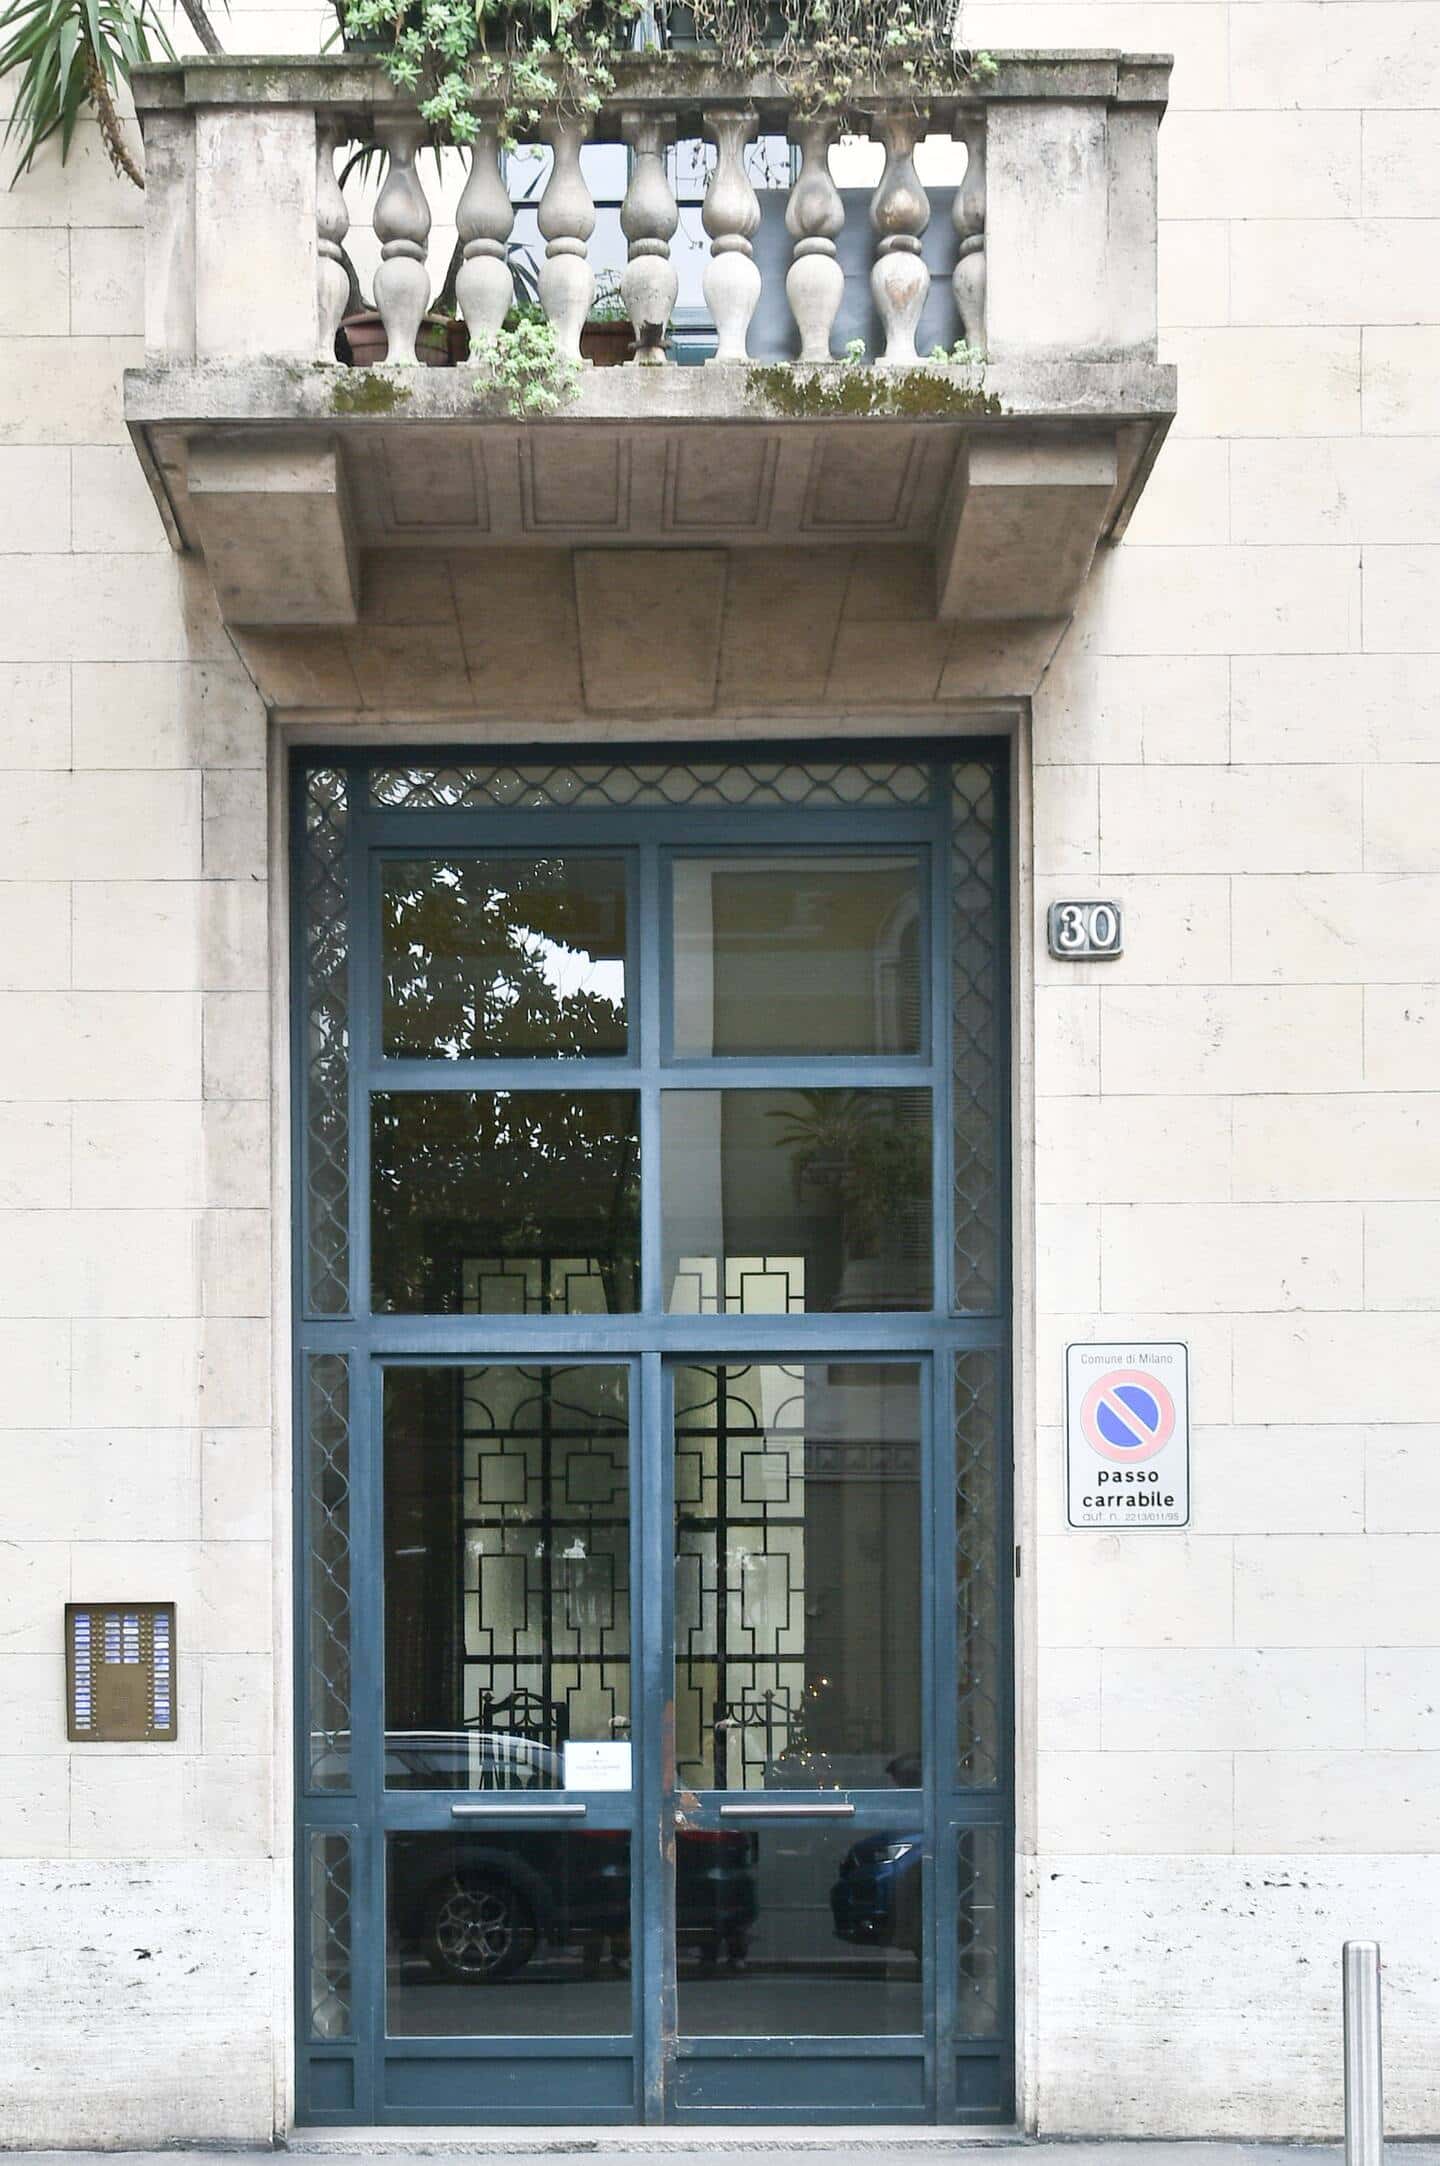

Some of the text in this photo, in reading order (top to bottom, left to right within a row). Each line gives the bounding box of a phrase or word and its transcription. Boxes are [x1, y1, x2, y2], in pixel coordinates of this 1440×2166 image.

[1060, 905, 1116, 947] 30
[1080, 1352, 1173, 1364] Comune di Milano
[1098, 1470, 1159, 1487] passo
[1082, 1491, 1175, 1507] carrabile
